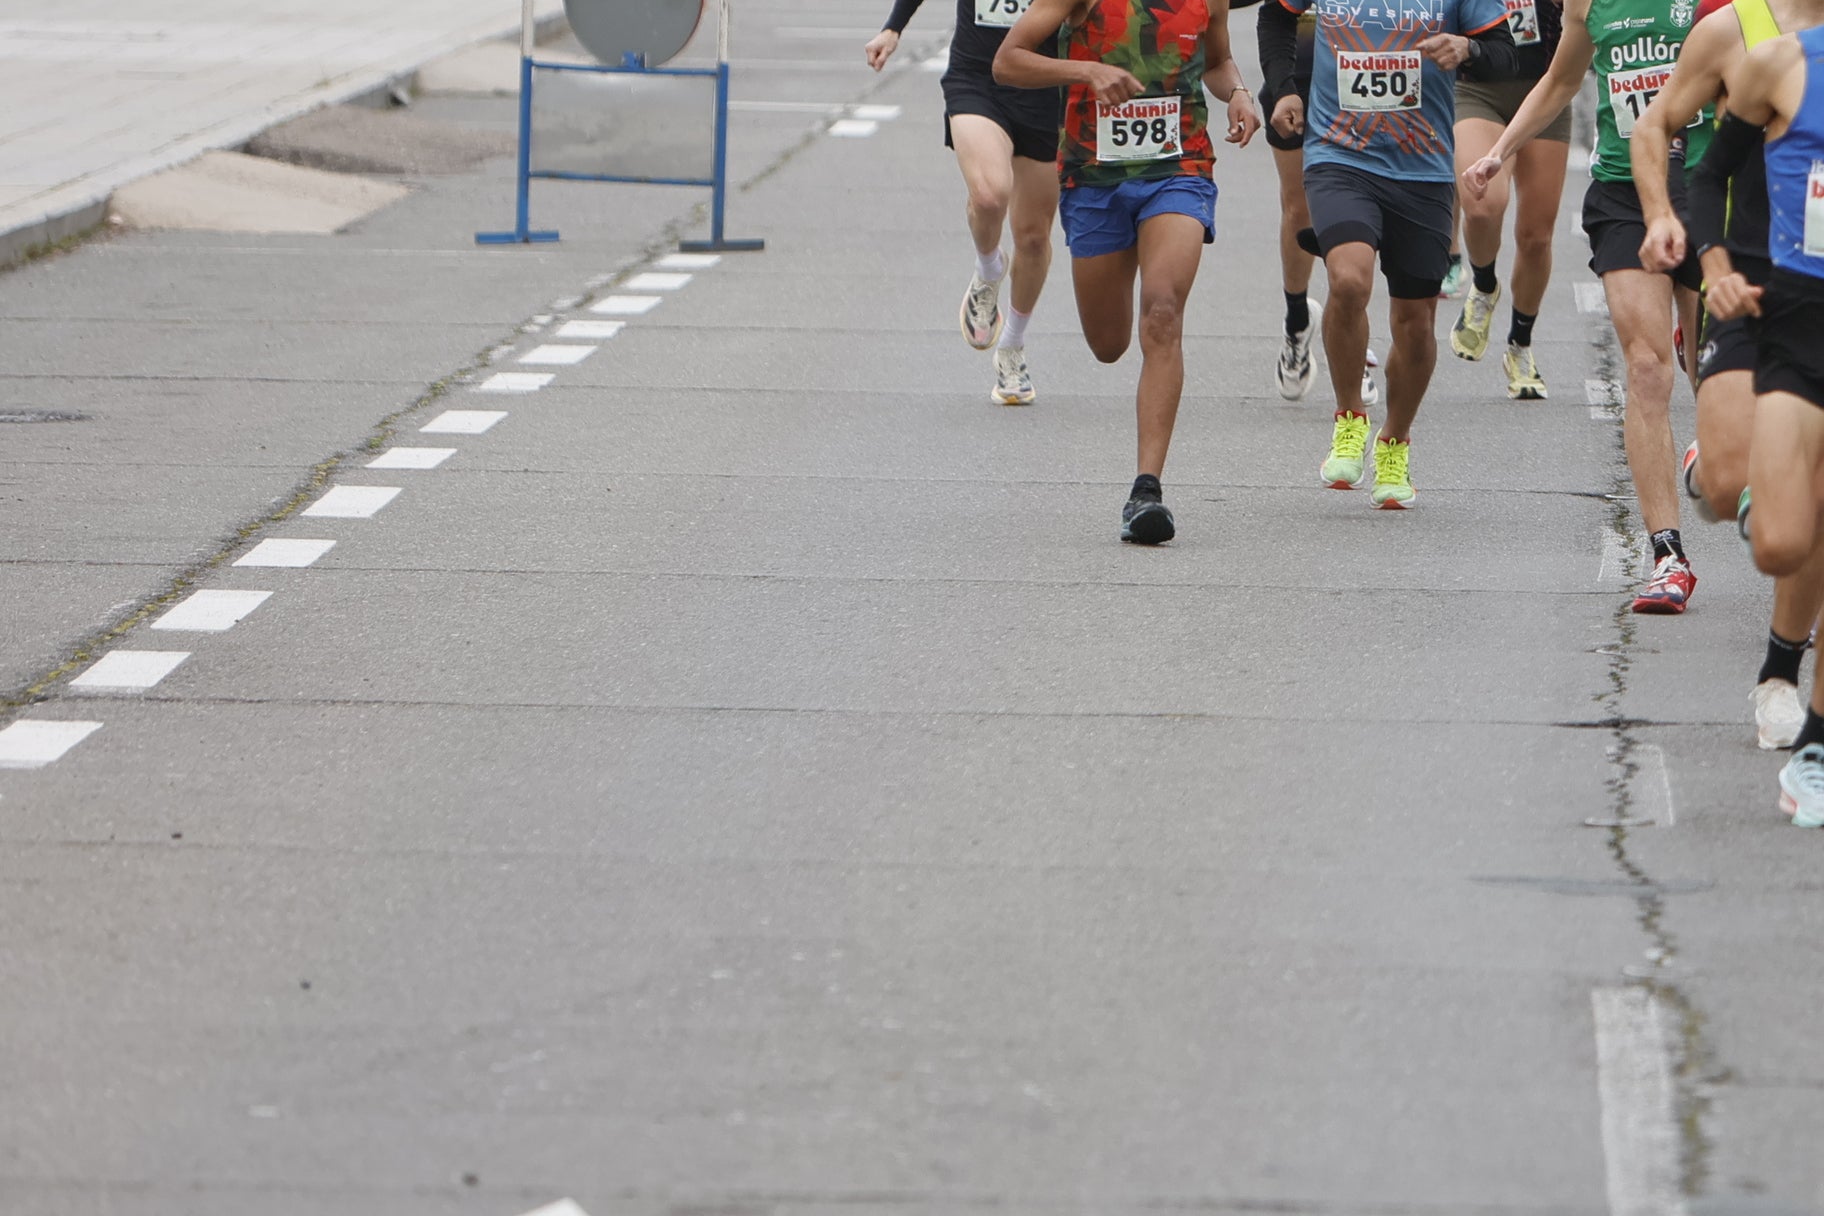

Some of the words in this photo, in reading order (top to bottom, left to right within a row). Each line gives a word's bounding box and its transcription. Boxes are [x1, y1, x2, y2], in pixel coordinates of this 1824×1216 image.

[1318, 5, 1444, 21] SILVESTRE
[1340, 55, 1419, 71] bedunia
[1351, 71, 1407, 97] 450
[1112, 118, 1167, 146] 598
